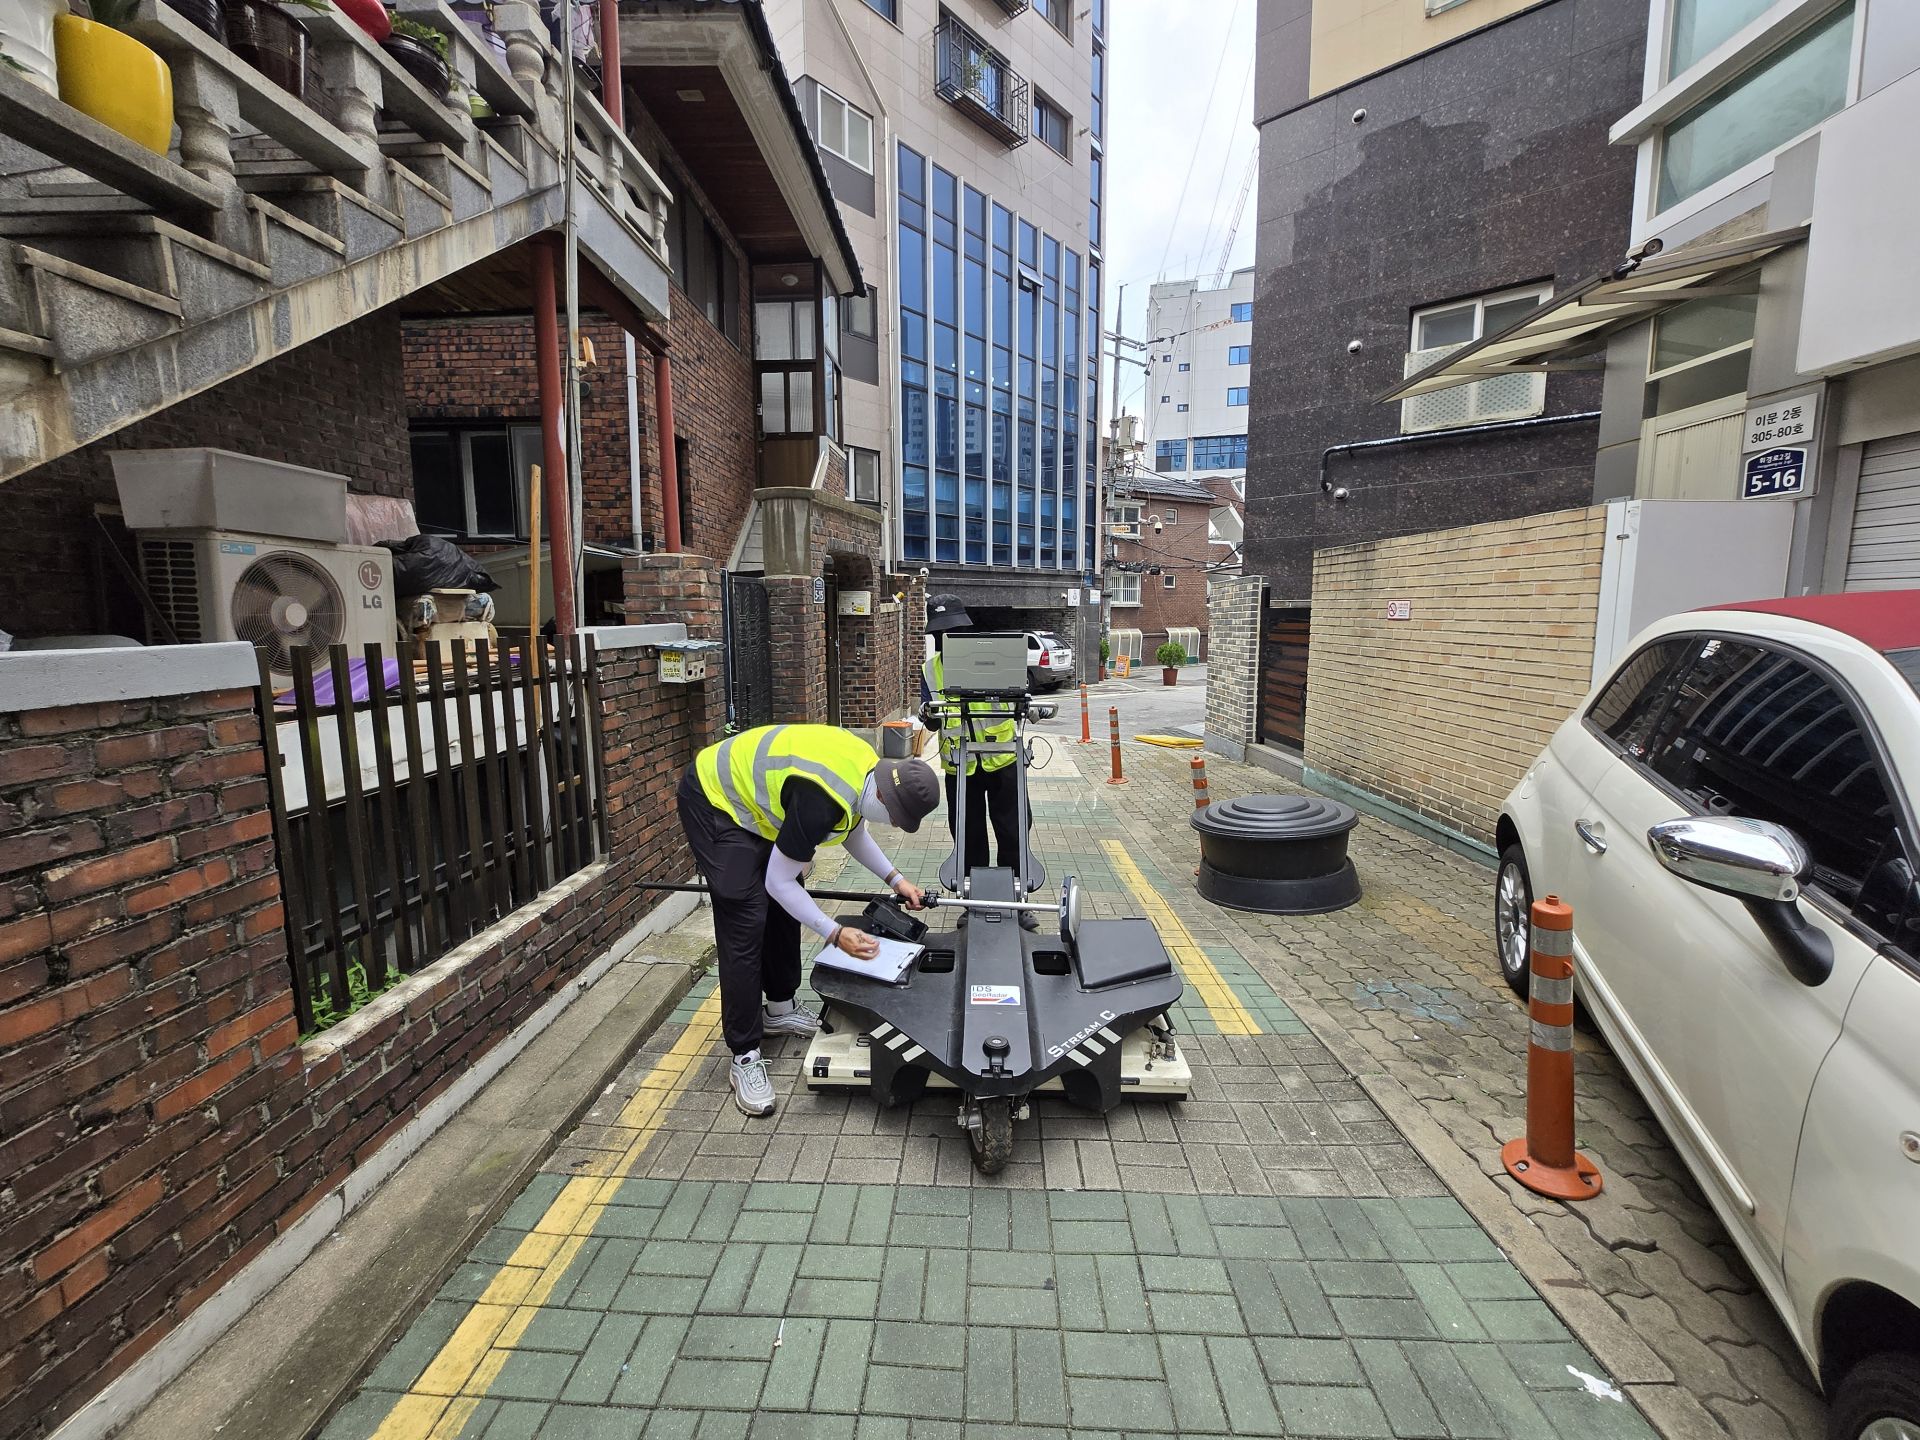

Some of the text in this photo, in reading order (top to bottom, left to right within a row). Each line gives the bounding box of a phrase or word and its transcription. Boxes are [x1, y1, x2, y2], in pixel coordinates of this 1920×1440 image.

[1755, 406, 1802, 426] 이문 2동
[1751, 423, 1804, 443] 305-80호
[1750, 468, 1796, 493] 5-16
[362, 595, 382, 609] LG
[972, 985, 992, 993] IDS
[1100, 1010, 1116, 1021] C
